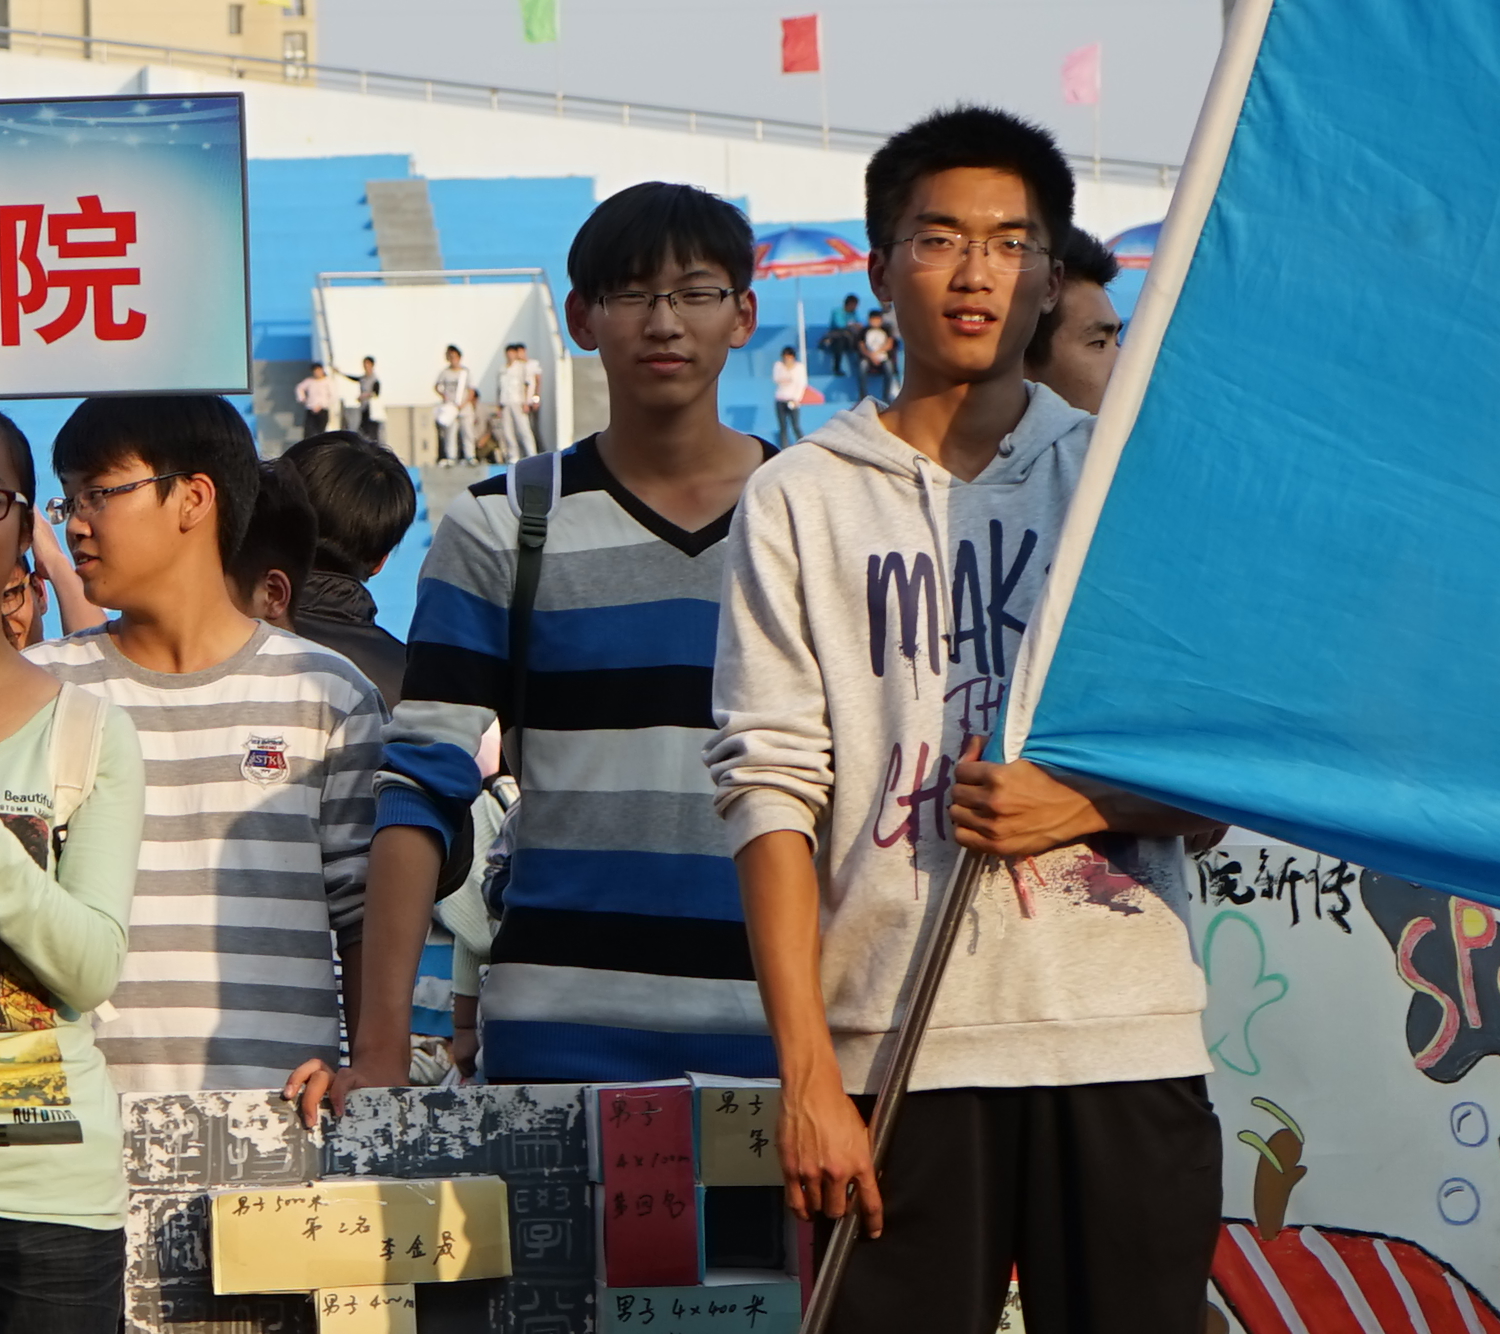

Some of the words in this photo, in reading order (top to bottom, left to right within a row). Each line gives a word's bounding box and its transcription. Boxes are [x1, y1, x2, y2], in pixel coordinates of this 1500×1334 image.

[867, 518, 1051, 678] MAK
[4, 789, 55, 810] Beautifu
[301, 1214, 372, 1242] 第二名
